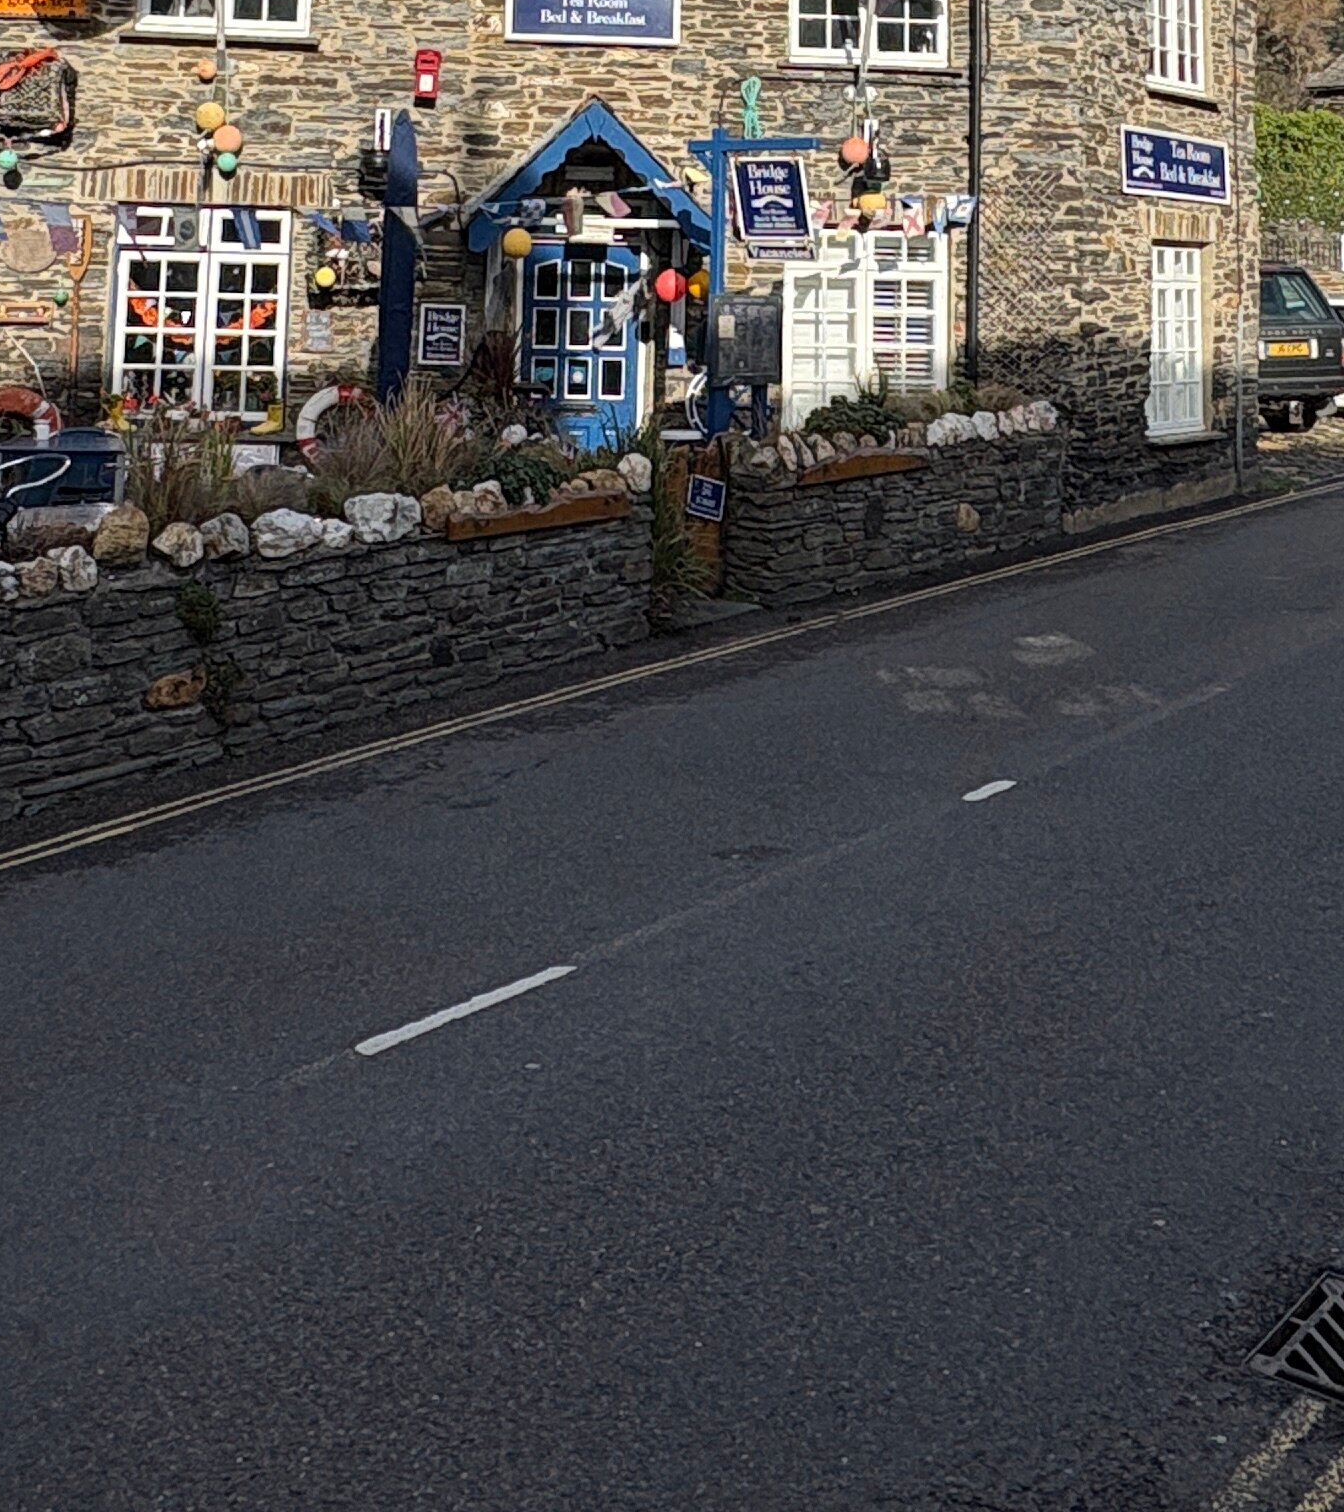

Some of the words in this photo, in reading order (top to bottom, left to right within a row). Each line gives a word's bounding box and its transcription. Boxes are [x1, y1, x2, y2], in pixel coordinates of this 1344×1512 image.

[540, 9, 567, 24] Bed
[570, 9, 584, 24] &
[586, 10, 647, 26] Breakfast
[1169, 140, 1186, 160] Tea
[1186, 142, 1211, 165] Room
[746, 163, 789, 182] Bridge
[1160, 161, 1178, 183] Bed
[748, 179, 792, 196] House
[748, 246, 812, 259] Vacancies
